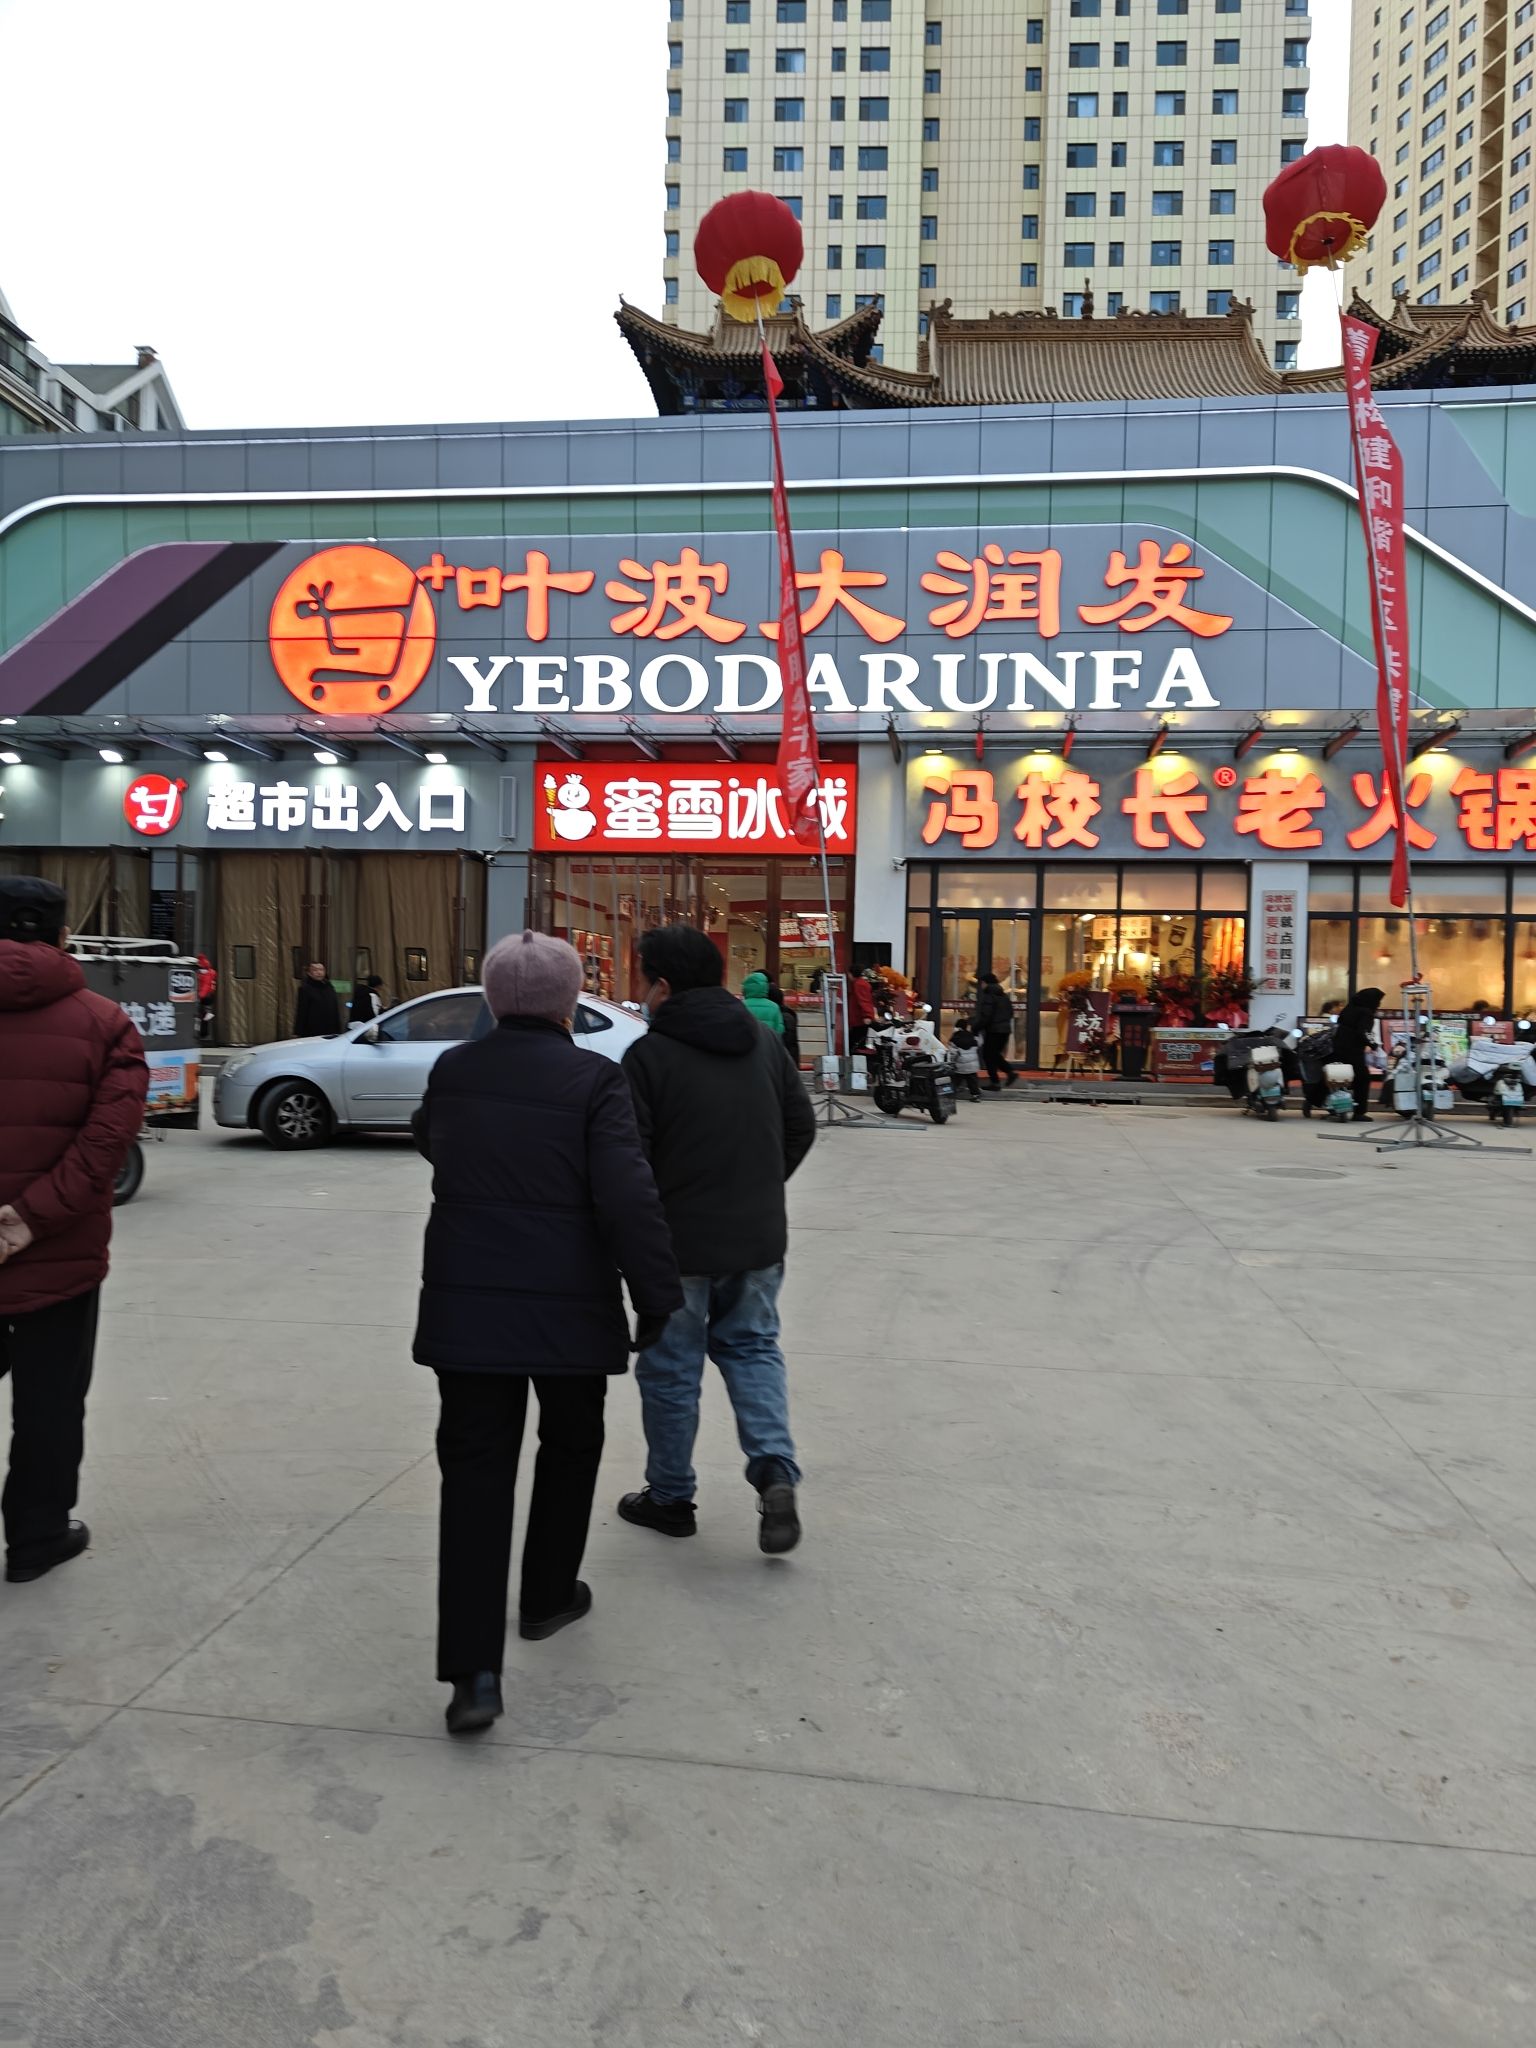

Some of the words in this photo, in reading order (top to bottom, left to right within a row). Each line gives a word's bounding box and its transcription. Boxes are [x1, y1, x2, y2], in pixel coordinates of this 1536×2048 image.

[455, 540, 1236, 645] 叶波大润发
[446, 647, 1221, 714] YEBODARUNFA
[206, 780, 467, 832] 超市出入口
